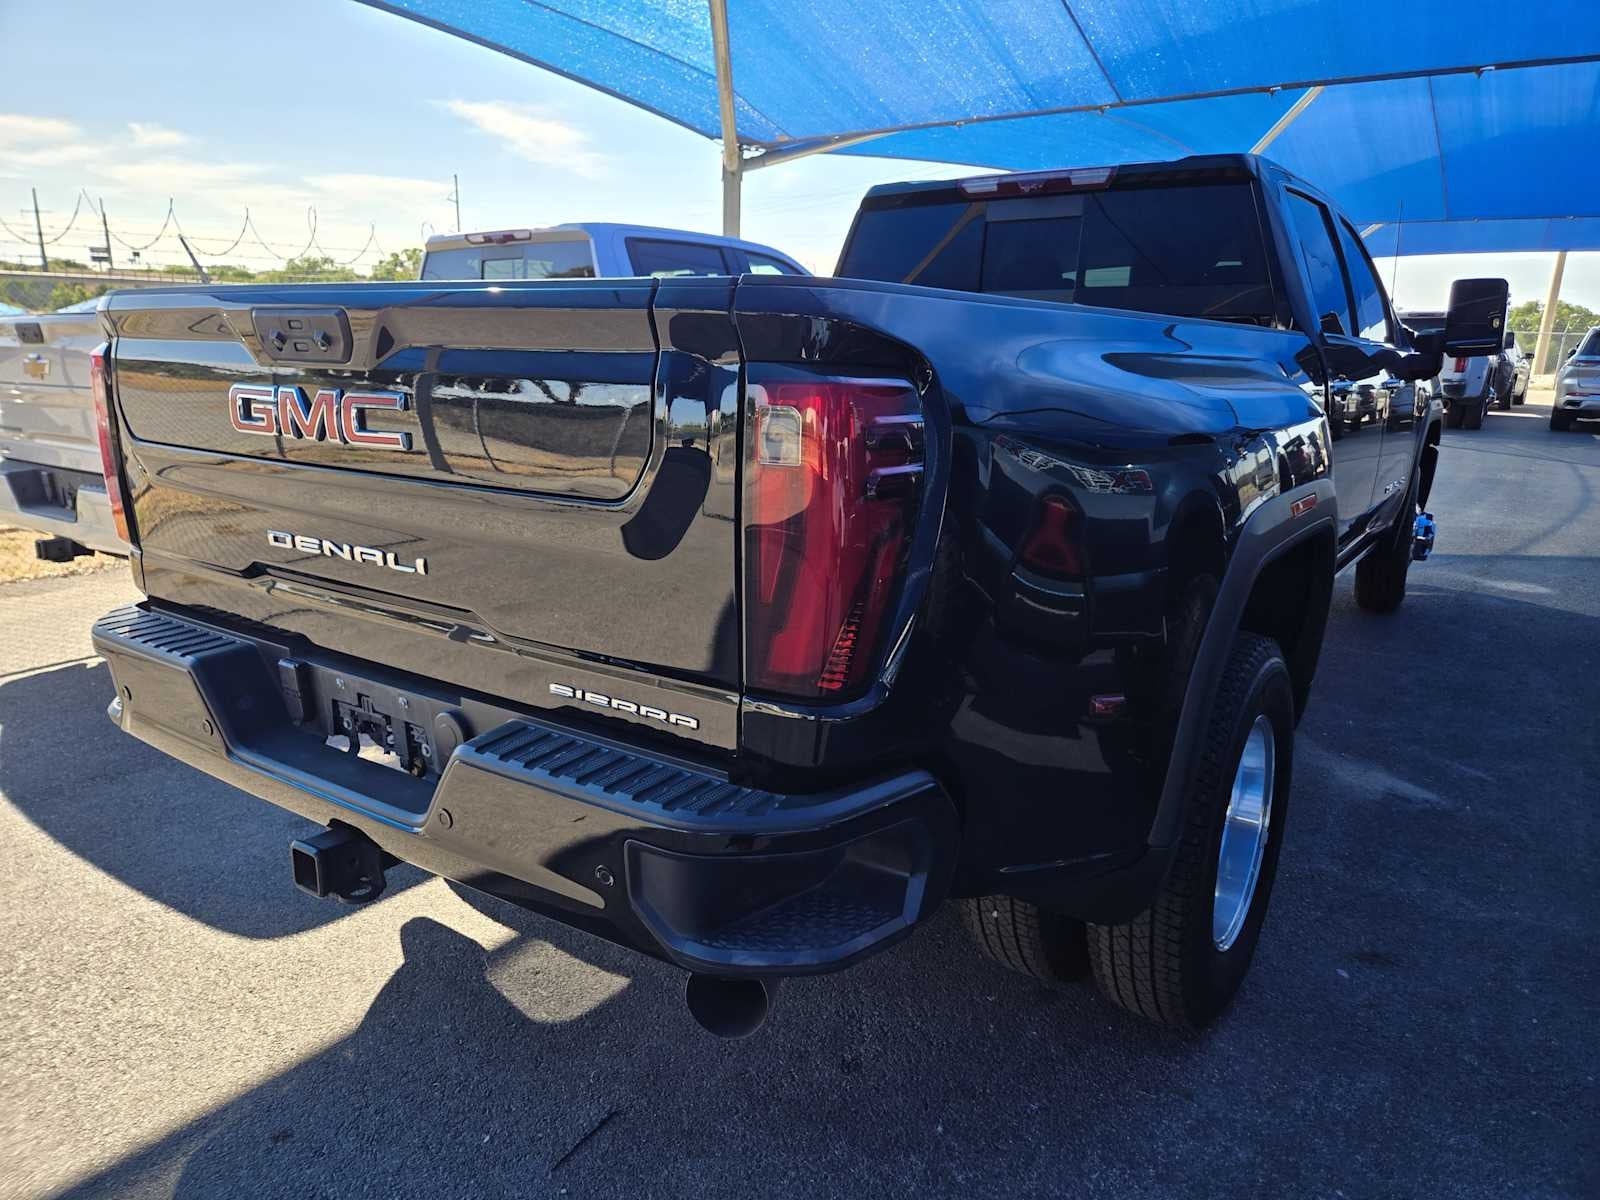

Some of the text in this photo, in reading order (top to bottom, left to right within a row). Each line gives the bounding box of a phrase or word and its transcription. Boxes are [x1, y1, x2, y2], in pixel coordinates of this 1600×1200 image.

[229, 384, 412, 450] GMC
[266, 529, 428, 575] DENALI
[549, 683, 699, 730] SIERRA
